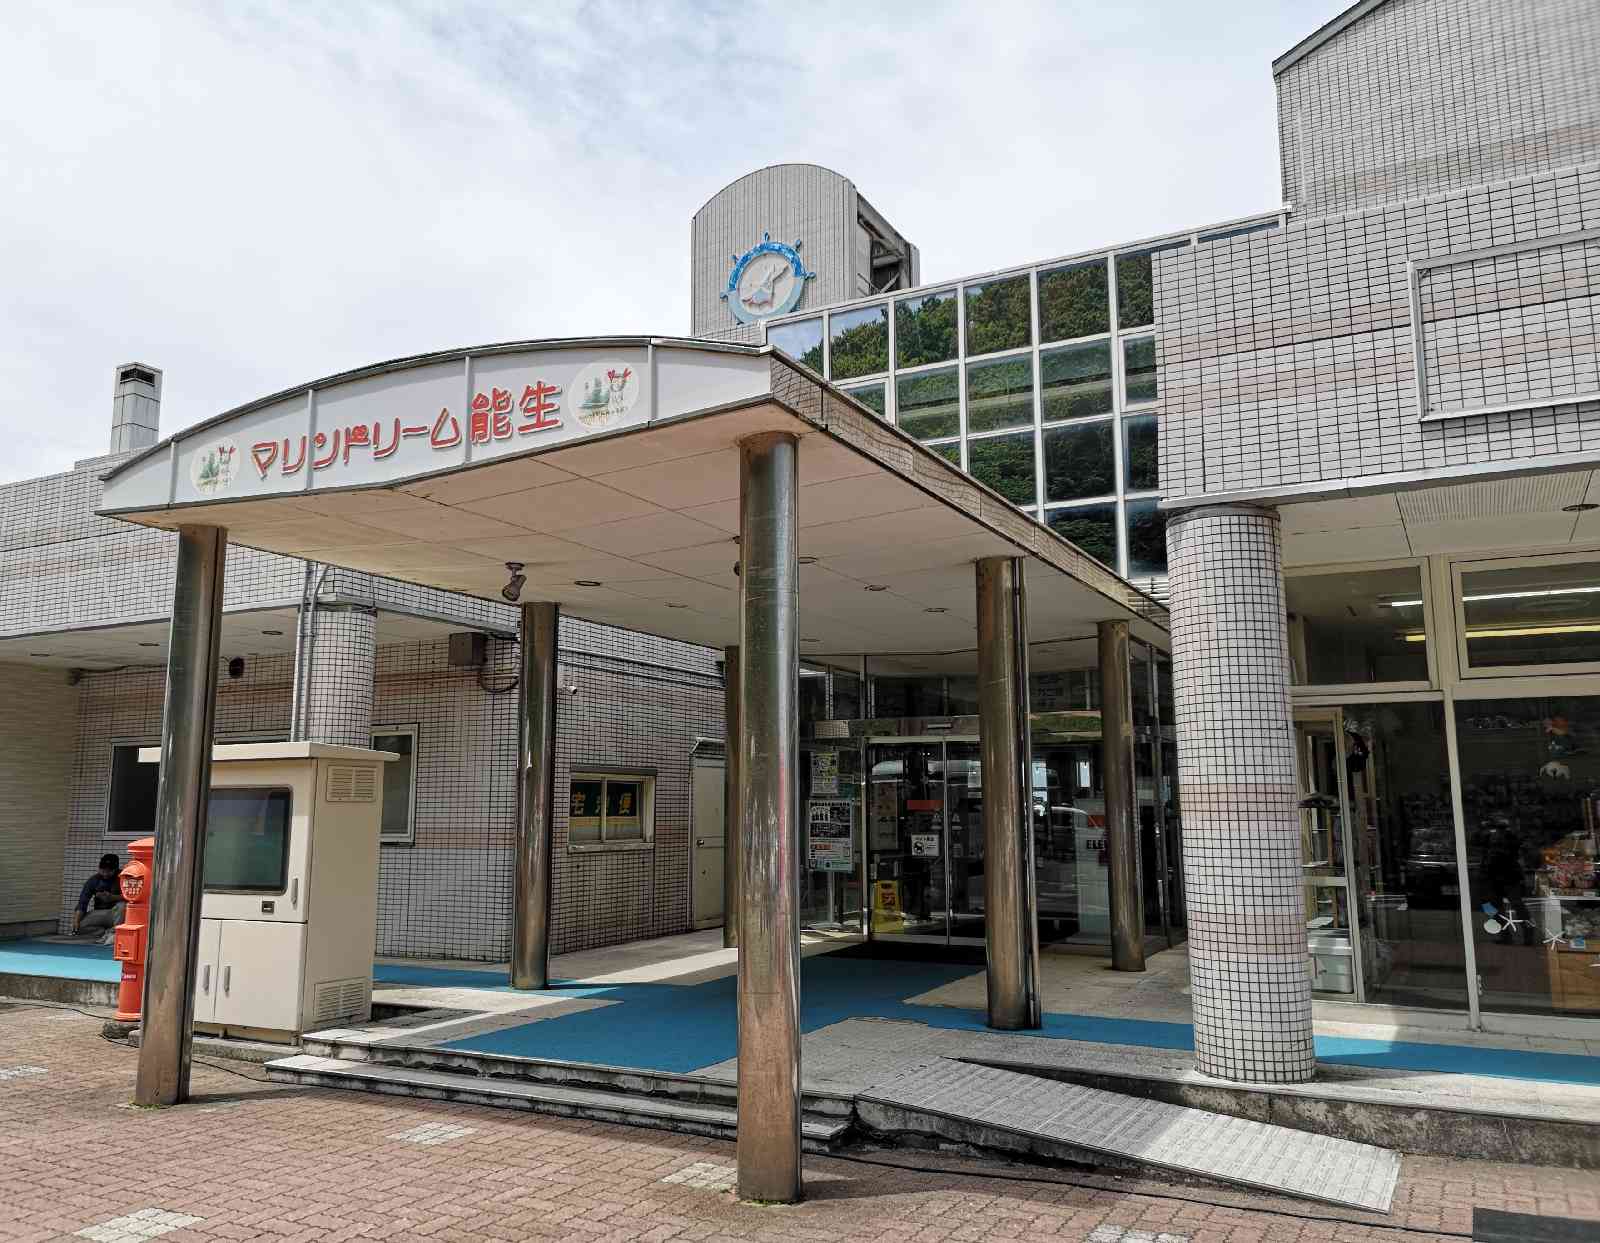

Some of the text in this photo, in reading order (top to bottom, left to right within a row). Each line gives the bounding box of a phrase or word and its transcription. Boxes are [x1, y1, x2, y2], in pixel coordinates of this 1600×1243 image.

[252, 380, 563, 480] マリンドリーム能生
